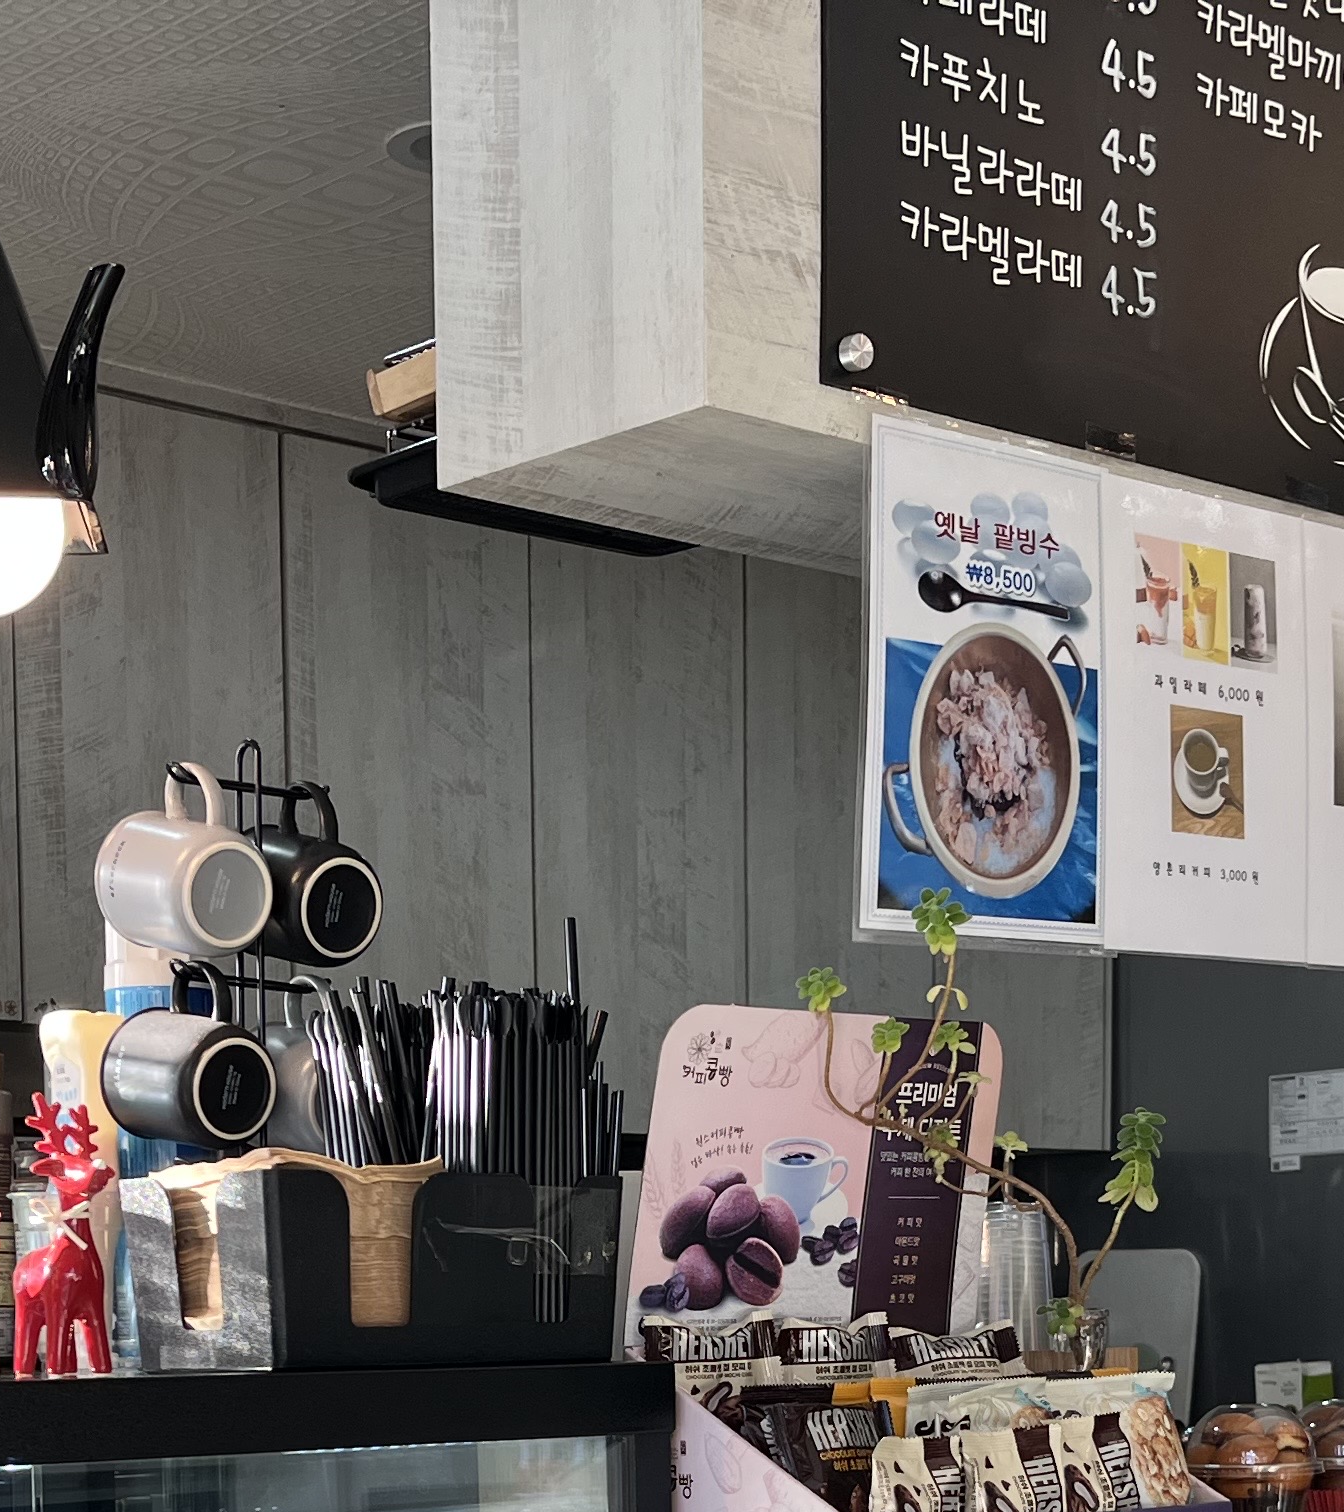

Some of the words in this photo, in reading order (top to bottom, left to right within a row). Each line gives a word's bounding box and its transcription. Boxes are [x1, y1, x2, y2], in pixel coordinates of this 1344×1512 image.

[900, 38, 1045, 125] 카푸치노
[1101, 38, 1157, 99] 4.5
[1197, 72, 1323, 152] 카페모카
[900, 120, 1083, 212] 바닐라라떼
[1101, 128, 1157, 176] 4.5
[900, 201, 1083, 287] 카라멜라떼
[1100, 199, 1157, 248] 4.5
[1101, 265, 1157, 318] 4.5
[935, 511, 980, 544] 옛날
[994, 522, 1060, 559] 팥빙수
[966, 563, 1033, 592] ₩8,500
[1218, 685, 1250, 702] 6,000
[1220, 869, 1247, 882] 3,000
[682, 1057, 733, 1087] 커피콩빵
